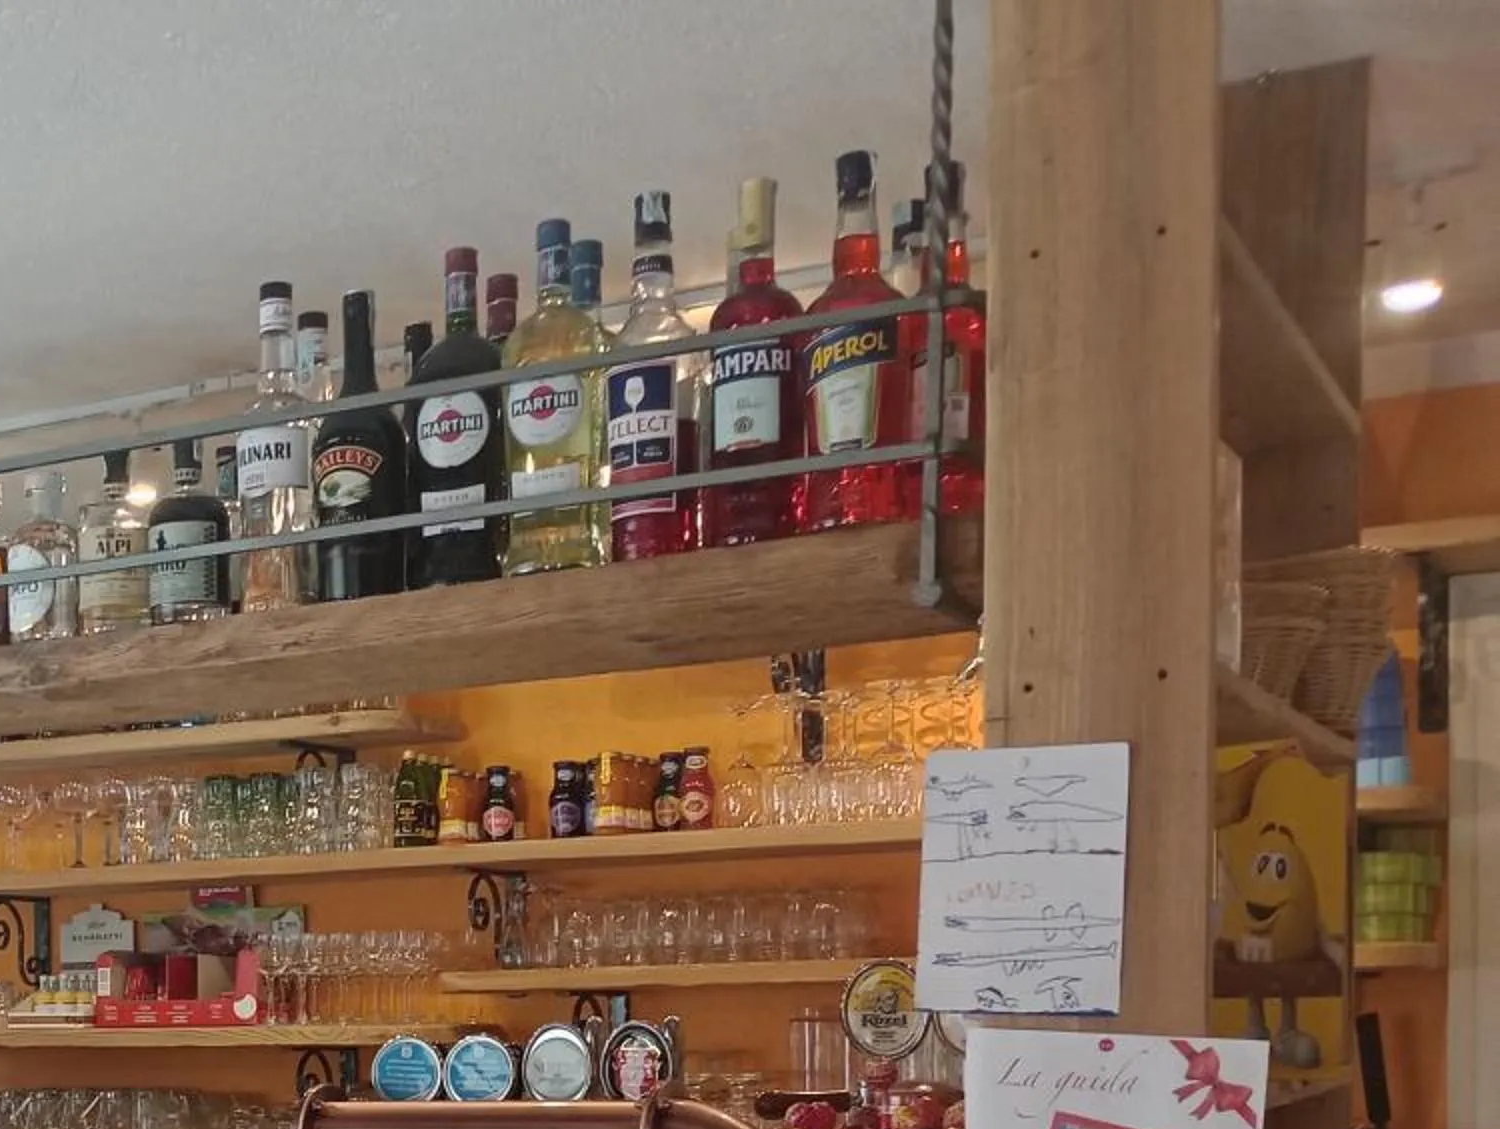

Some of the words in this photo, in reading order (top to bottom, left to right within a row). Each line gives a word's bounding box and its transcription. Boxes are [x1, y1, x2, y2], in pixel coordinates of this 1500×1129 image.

[713, 349, 791, 381] AMPARI
[810, 329, 889, 380] APEROL
[512, 390, 578, 417] MARTINI
[421, 414, 483, 440] MARTINI
[610, 414, 672, 442] SELECT
[240, 442, 291, 468] LINARI
[997, 1057, 1041, 1088] La
[1050, 1049, 1148, 1105] guida
